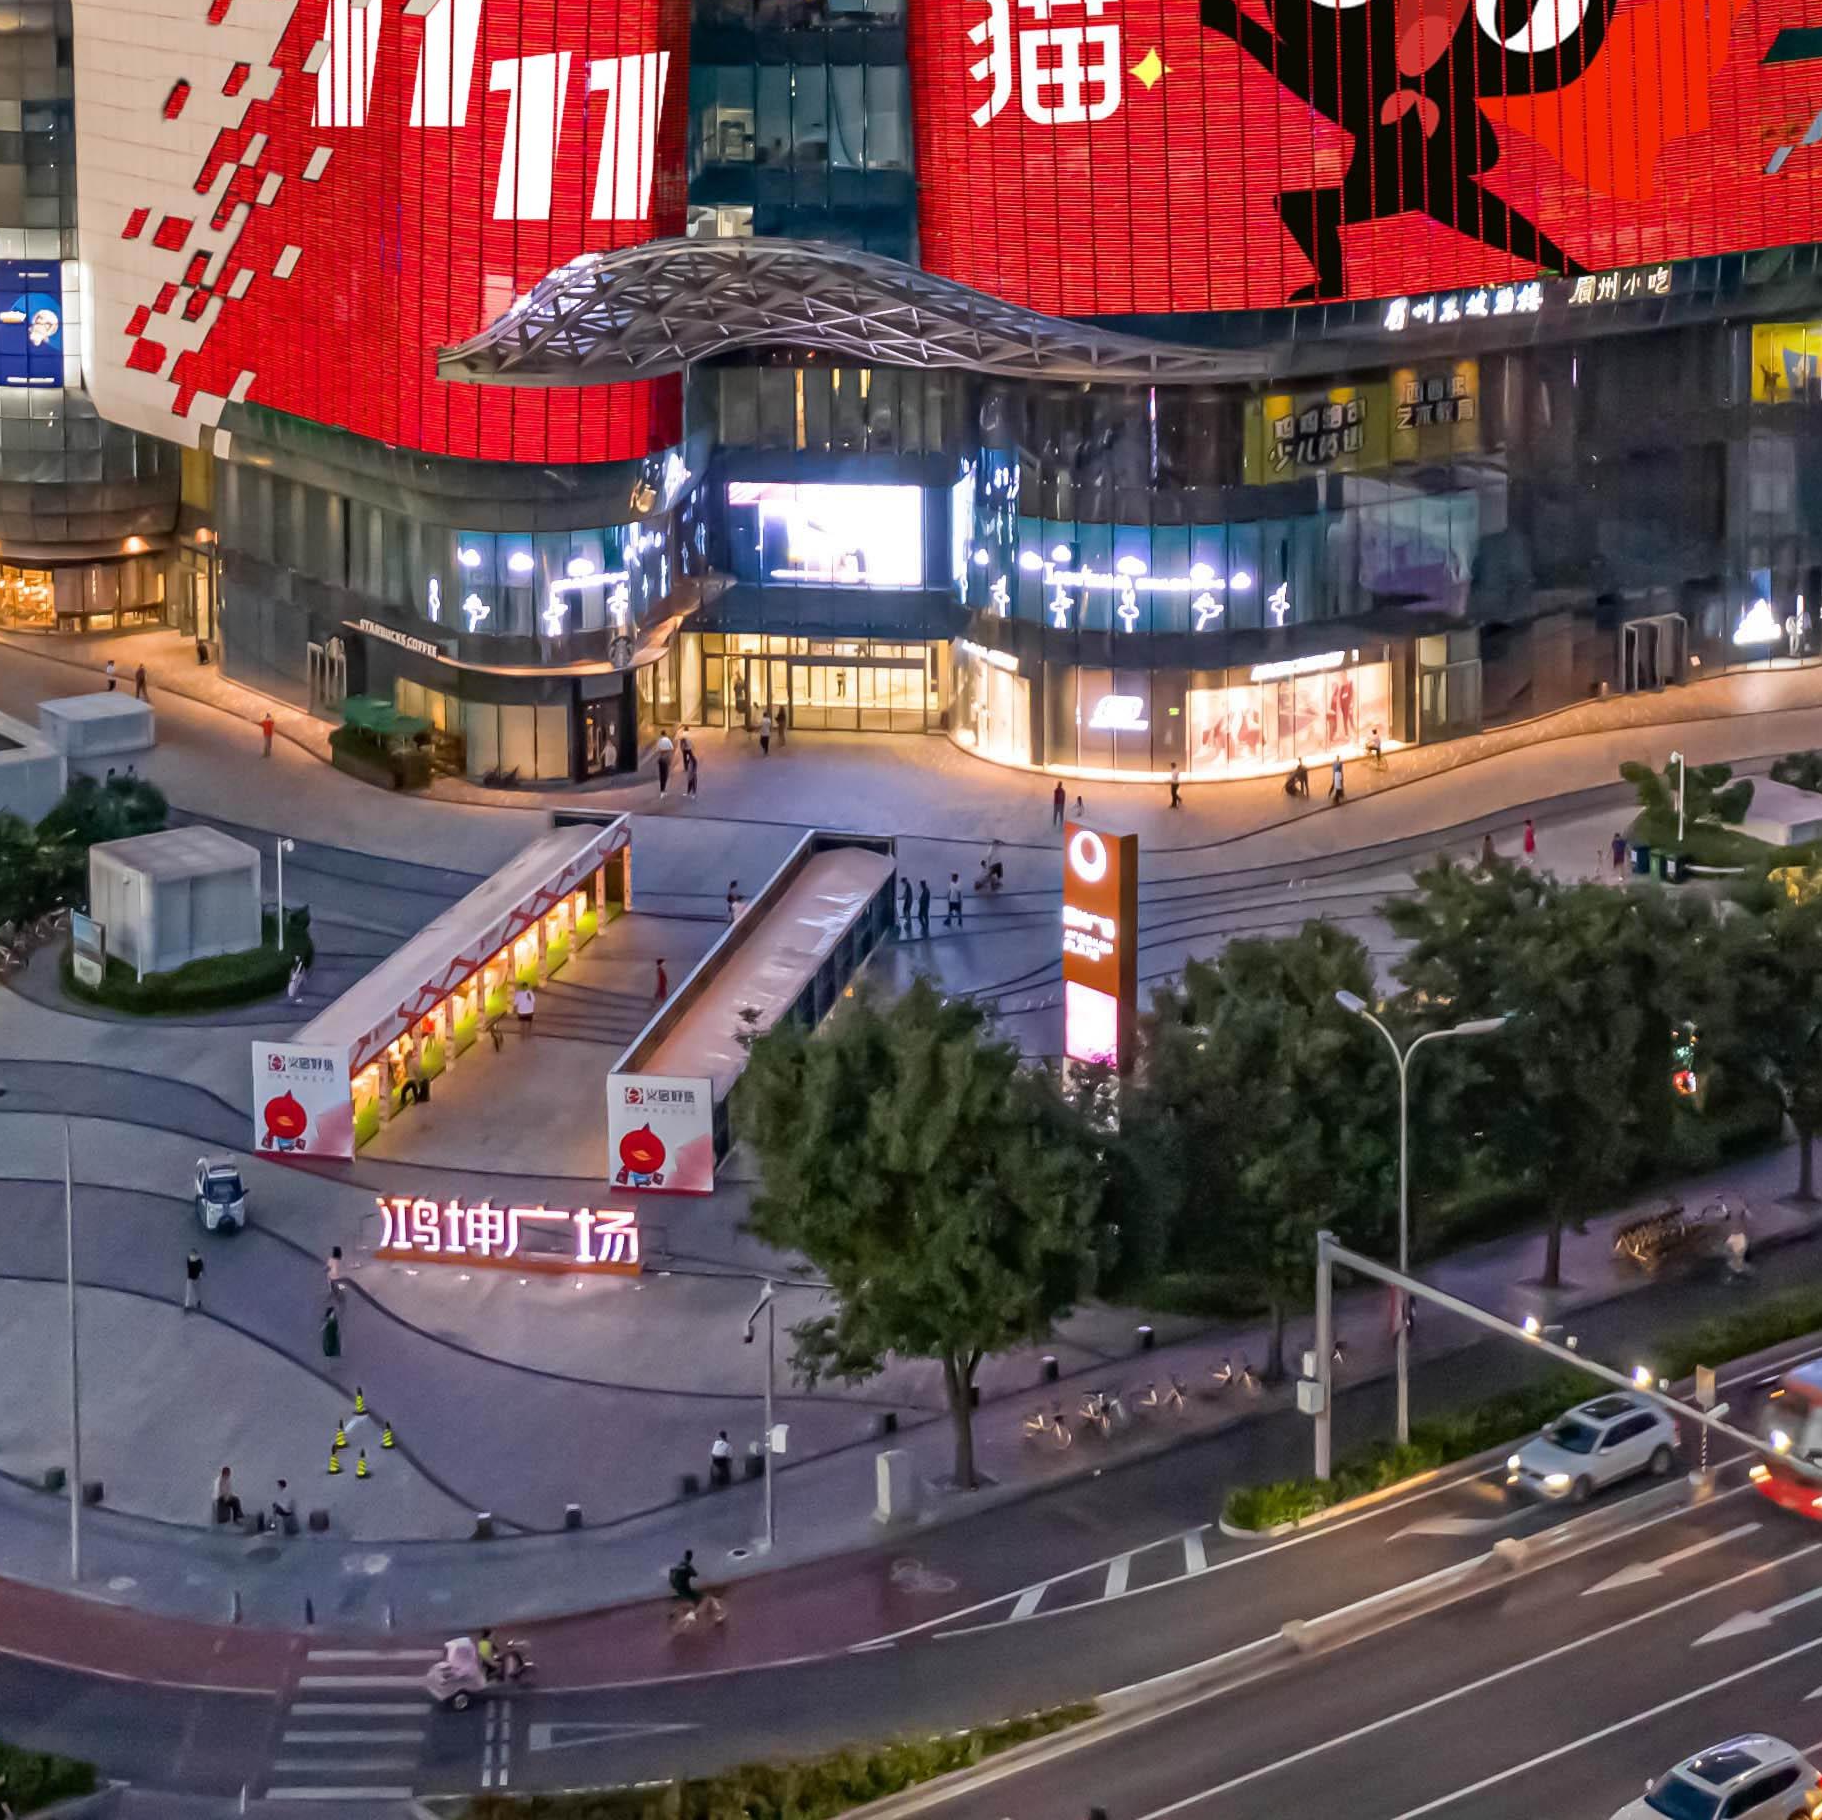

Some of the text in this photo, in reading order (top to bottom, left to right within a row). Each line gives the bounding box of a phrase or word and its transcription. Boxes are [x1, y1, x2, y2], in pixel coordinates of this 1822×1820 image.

[1568, 266, 1670, 305] 眉州小吃
[358, 617, 439, 659] STARBUCKS COFFEE
[375, 1196, 640, 1265] 鸿坤广场
